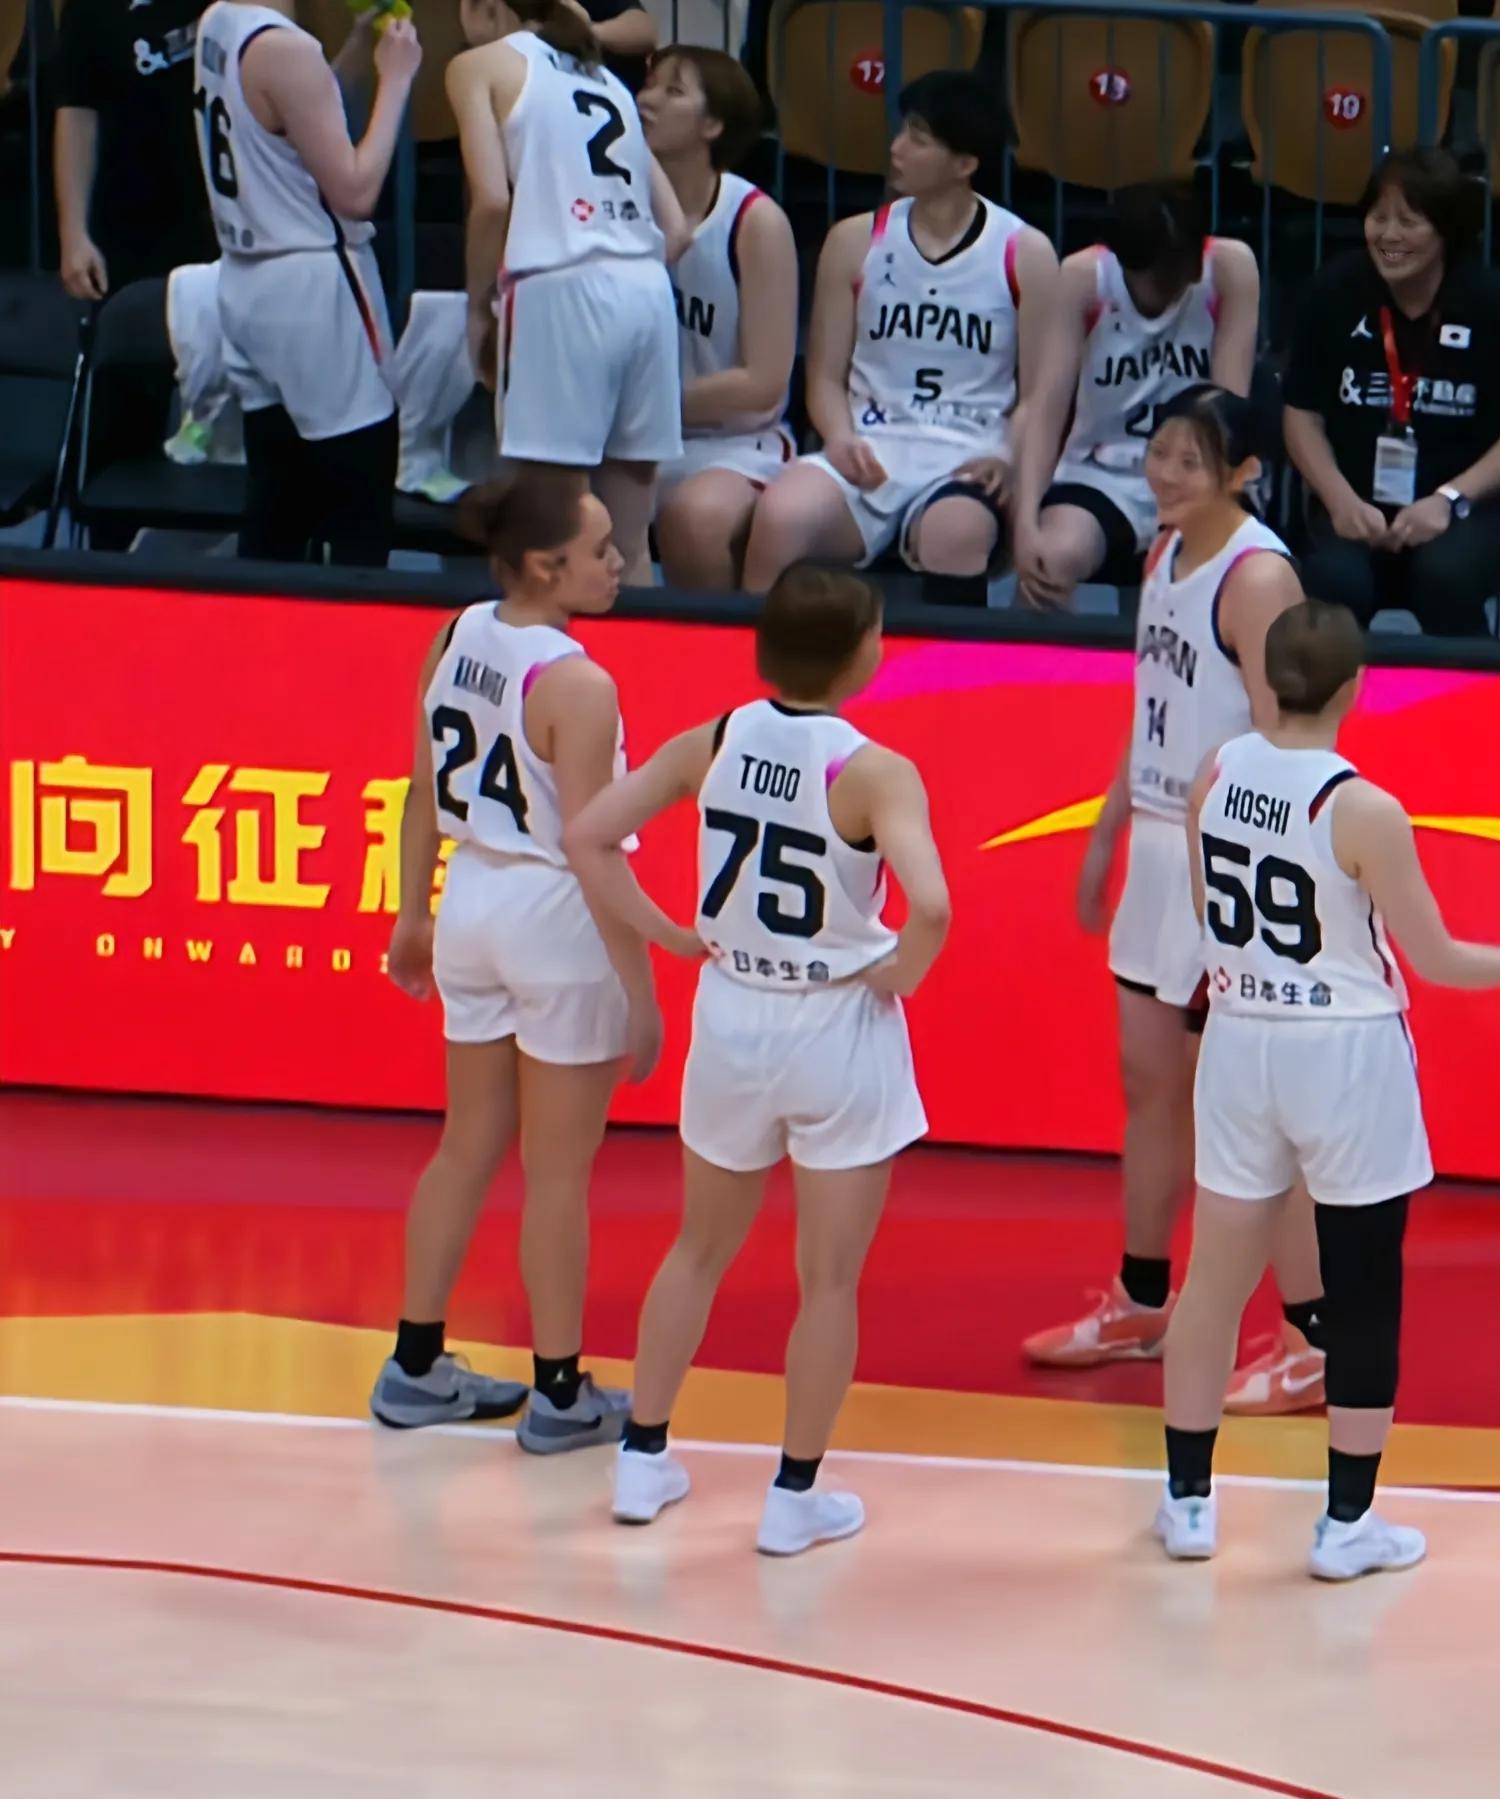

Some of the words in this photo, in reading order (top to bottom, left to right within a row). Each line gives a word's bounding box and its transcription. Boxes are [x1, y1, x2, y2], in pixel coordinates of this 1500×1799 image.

[573, 89, 631, 185] 2
[869, 302, 992, 355] JAPAN
[913, 368, 944, 401] 5
[1094, 341, 1211, 387] JAPAN
[1148, 696, 1167, 748] 14
[432, 704, 530, 835] 24
[740, 754, 801, 802] TODO
[1224, 783, 1291, 836] HOSHI
[701, 806, 827, 939] 75
[1201, 831, 1322, 965] 59
